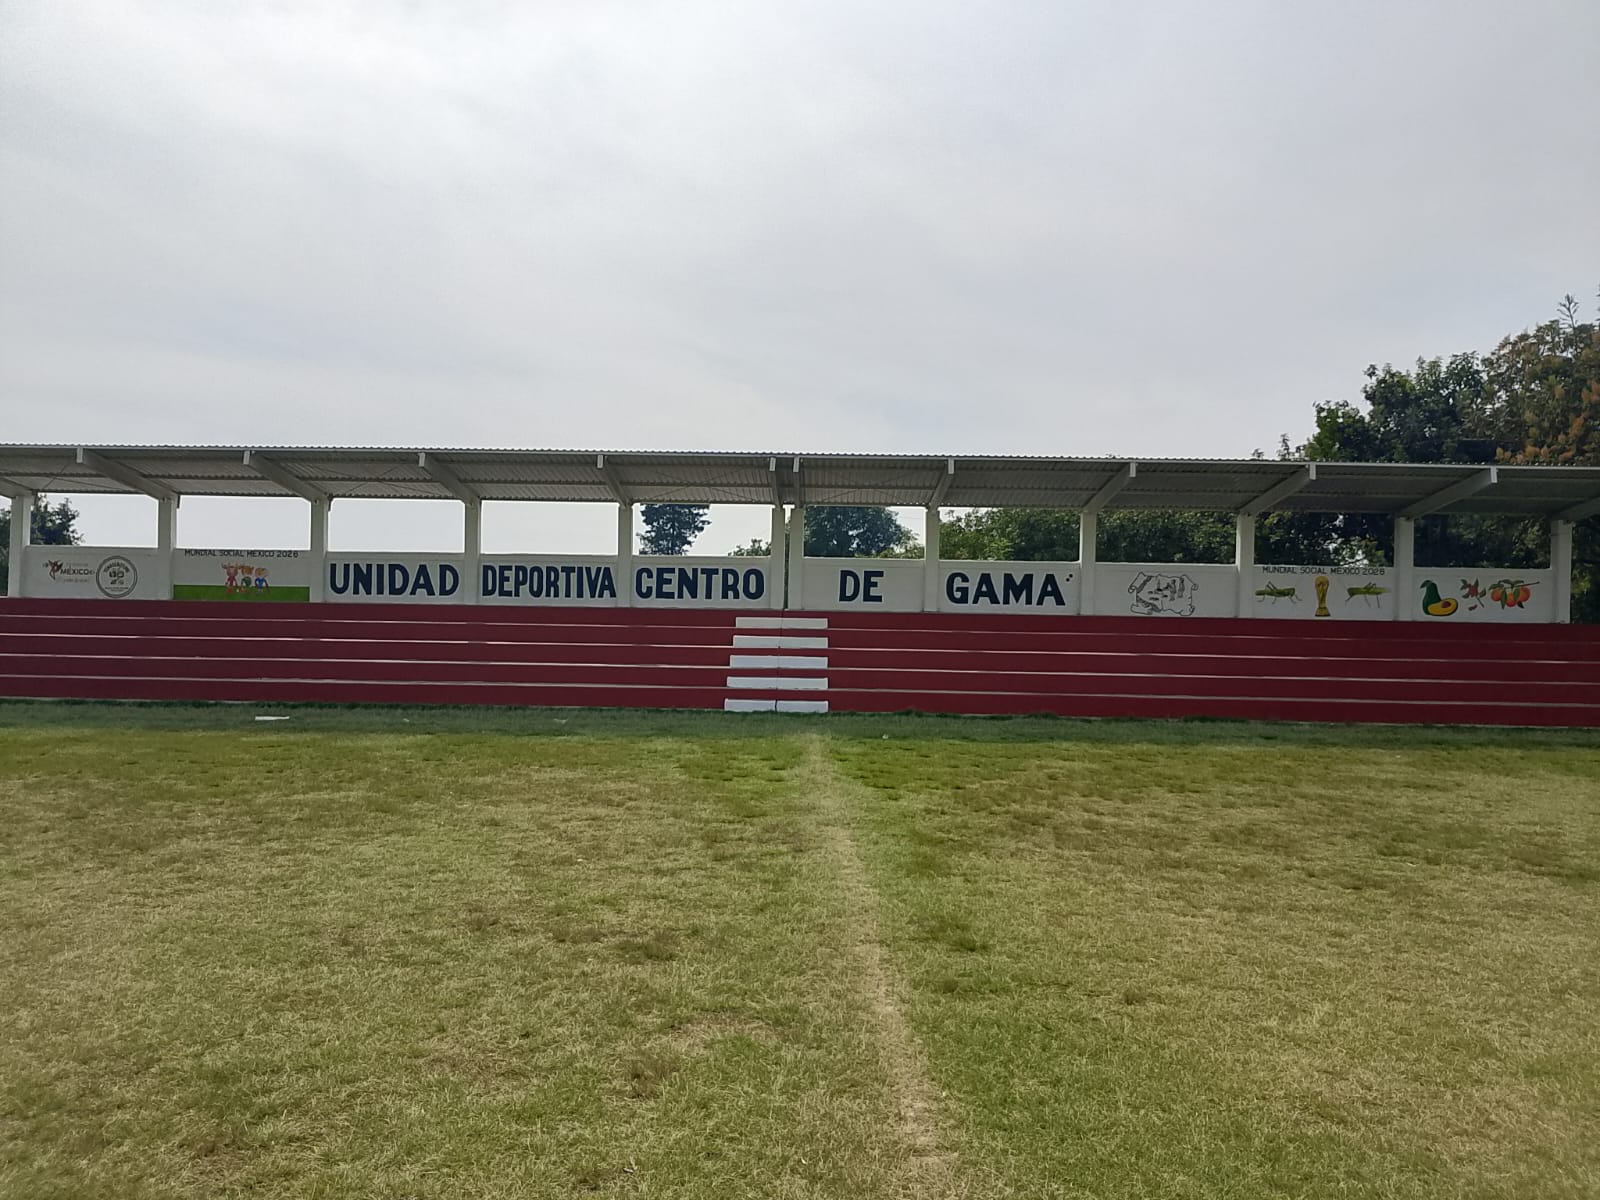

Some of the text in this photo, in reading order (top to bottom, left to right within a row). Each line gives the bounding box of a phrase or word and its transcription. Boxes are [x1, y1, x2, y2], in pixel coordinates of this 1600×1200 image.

[1262, 566, 1297, 575] MUNDIAL
[1299, 567, 1327, 575] SOCIAL
[1361, 568, 1385, 576] 2026
[330, 563, 1066, 607] UNIDAD DEPORTIVA CENTRO DE GAMA
